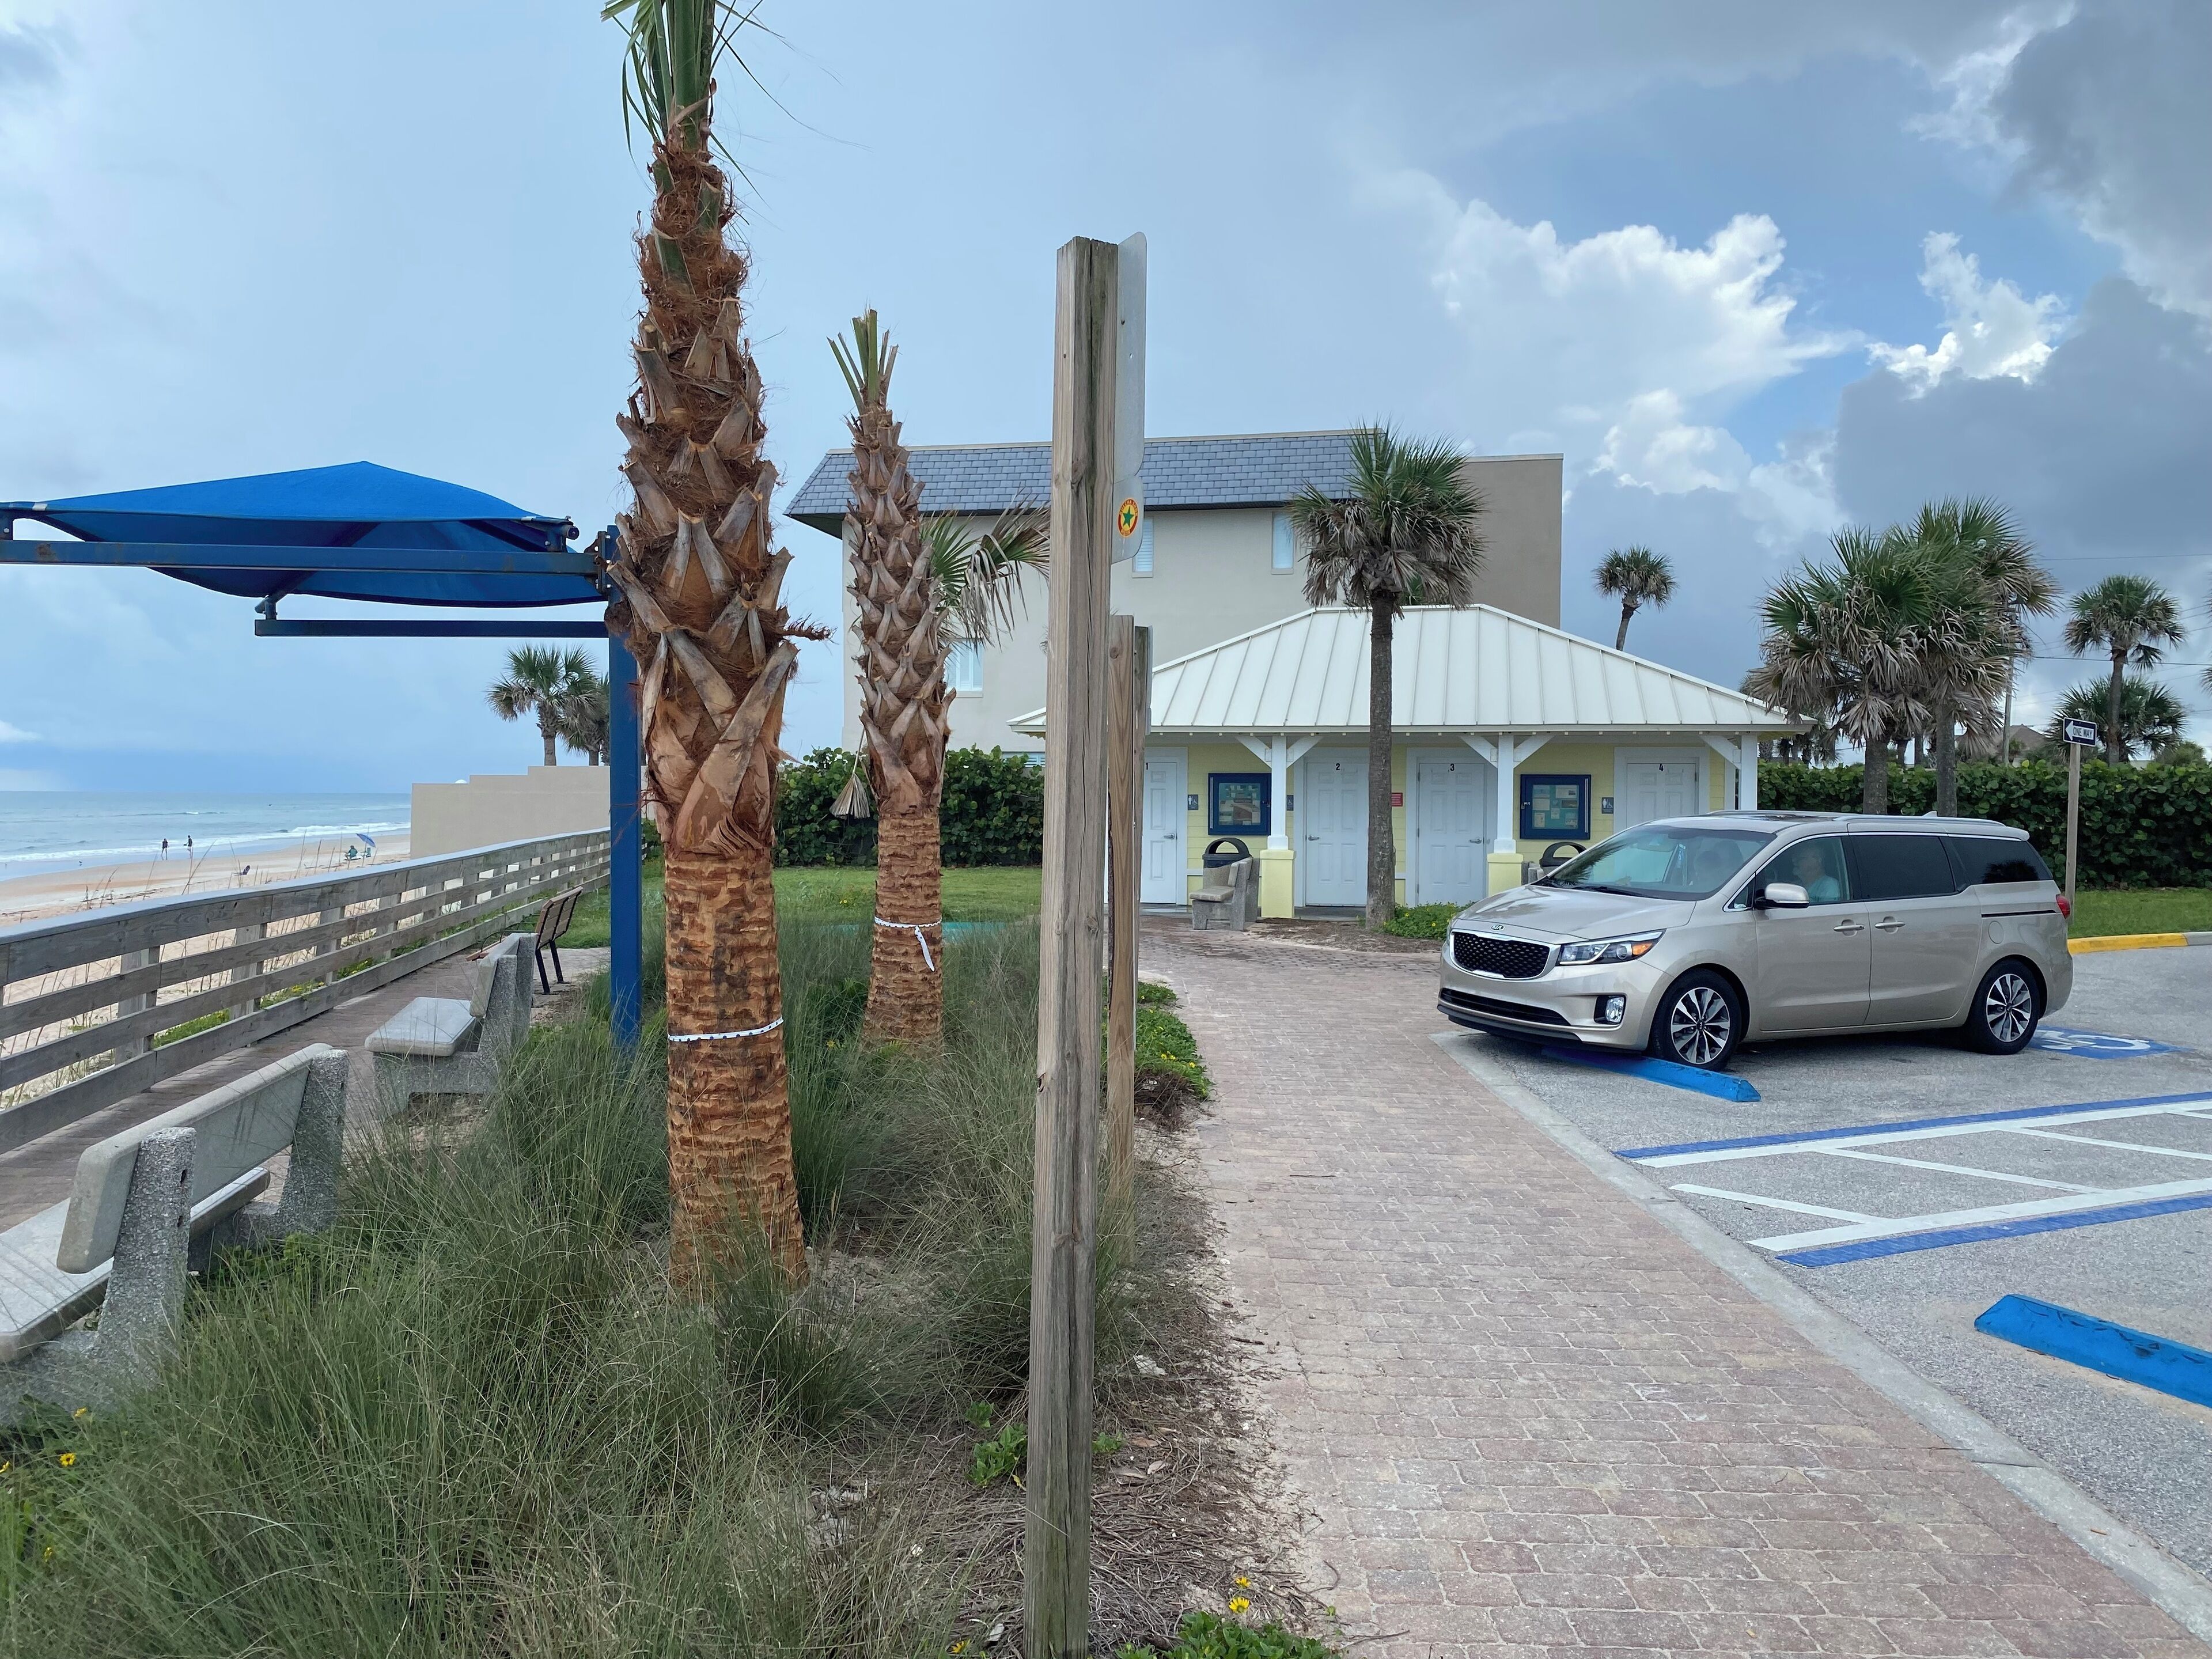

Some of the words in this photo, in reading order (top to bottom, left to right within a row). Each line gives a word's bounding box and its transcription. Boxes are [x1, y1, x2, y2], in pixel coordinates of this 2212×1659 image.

[2073, 726, 2082, 737] ONE
[2083, 728, 2093, 738] WAY
[1450, 763, 1455, 771] 3
[1659, 763, 1664, 771] 4
